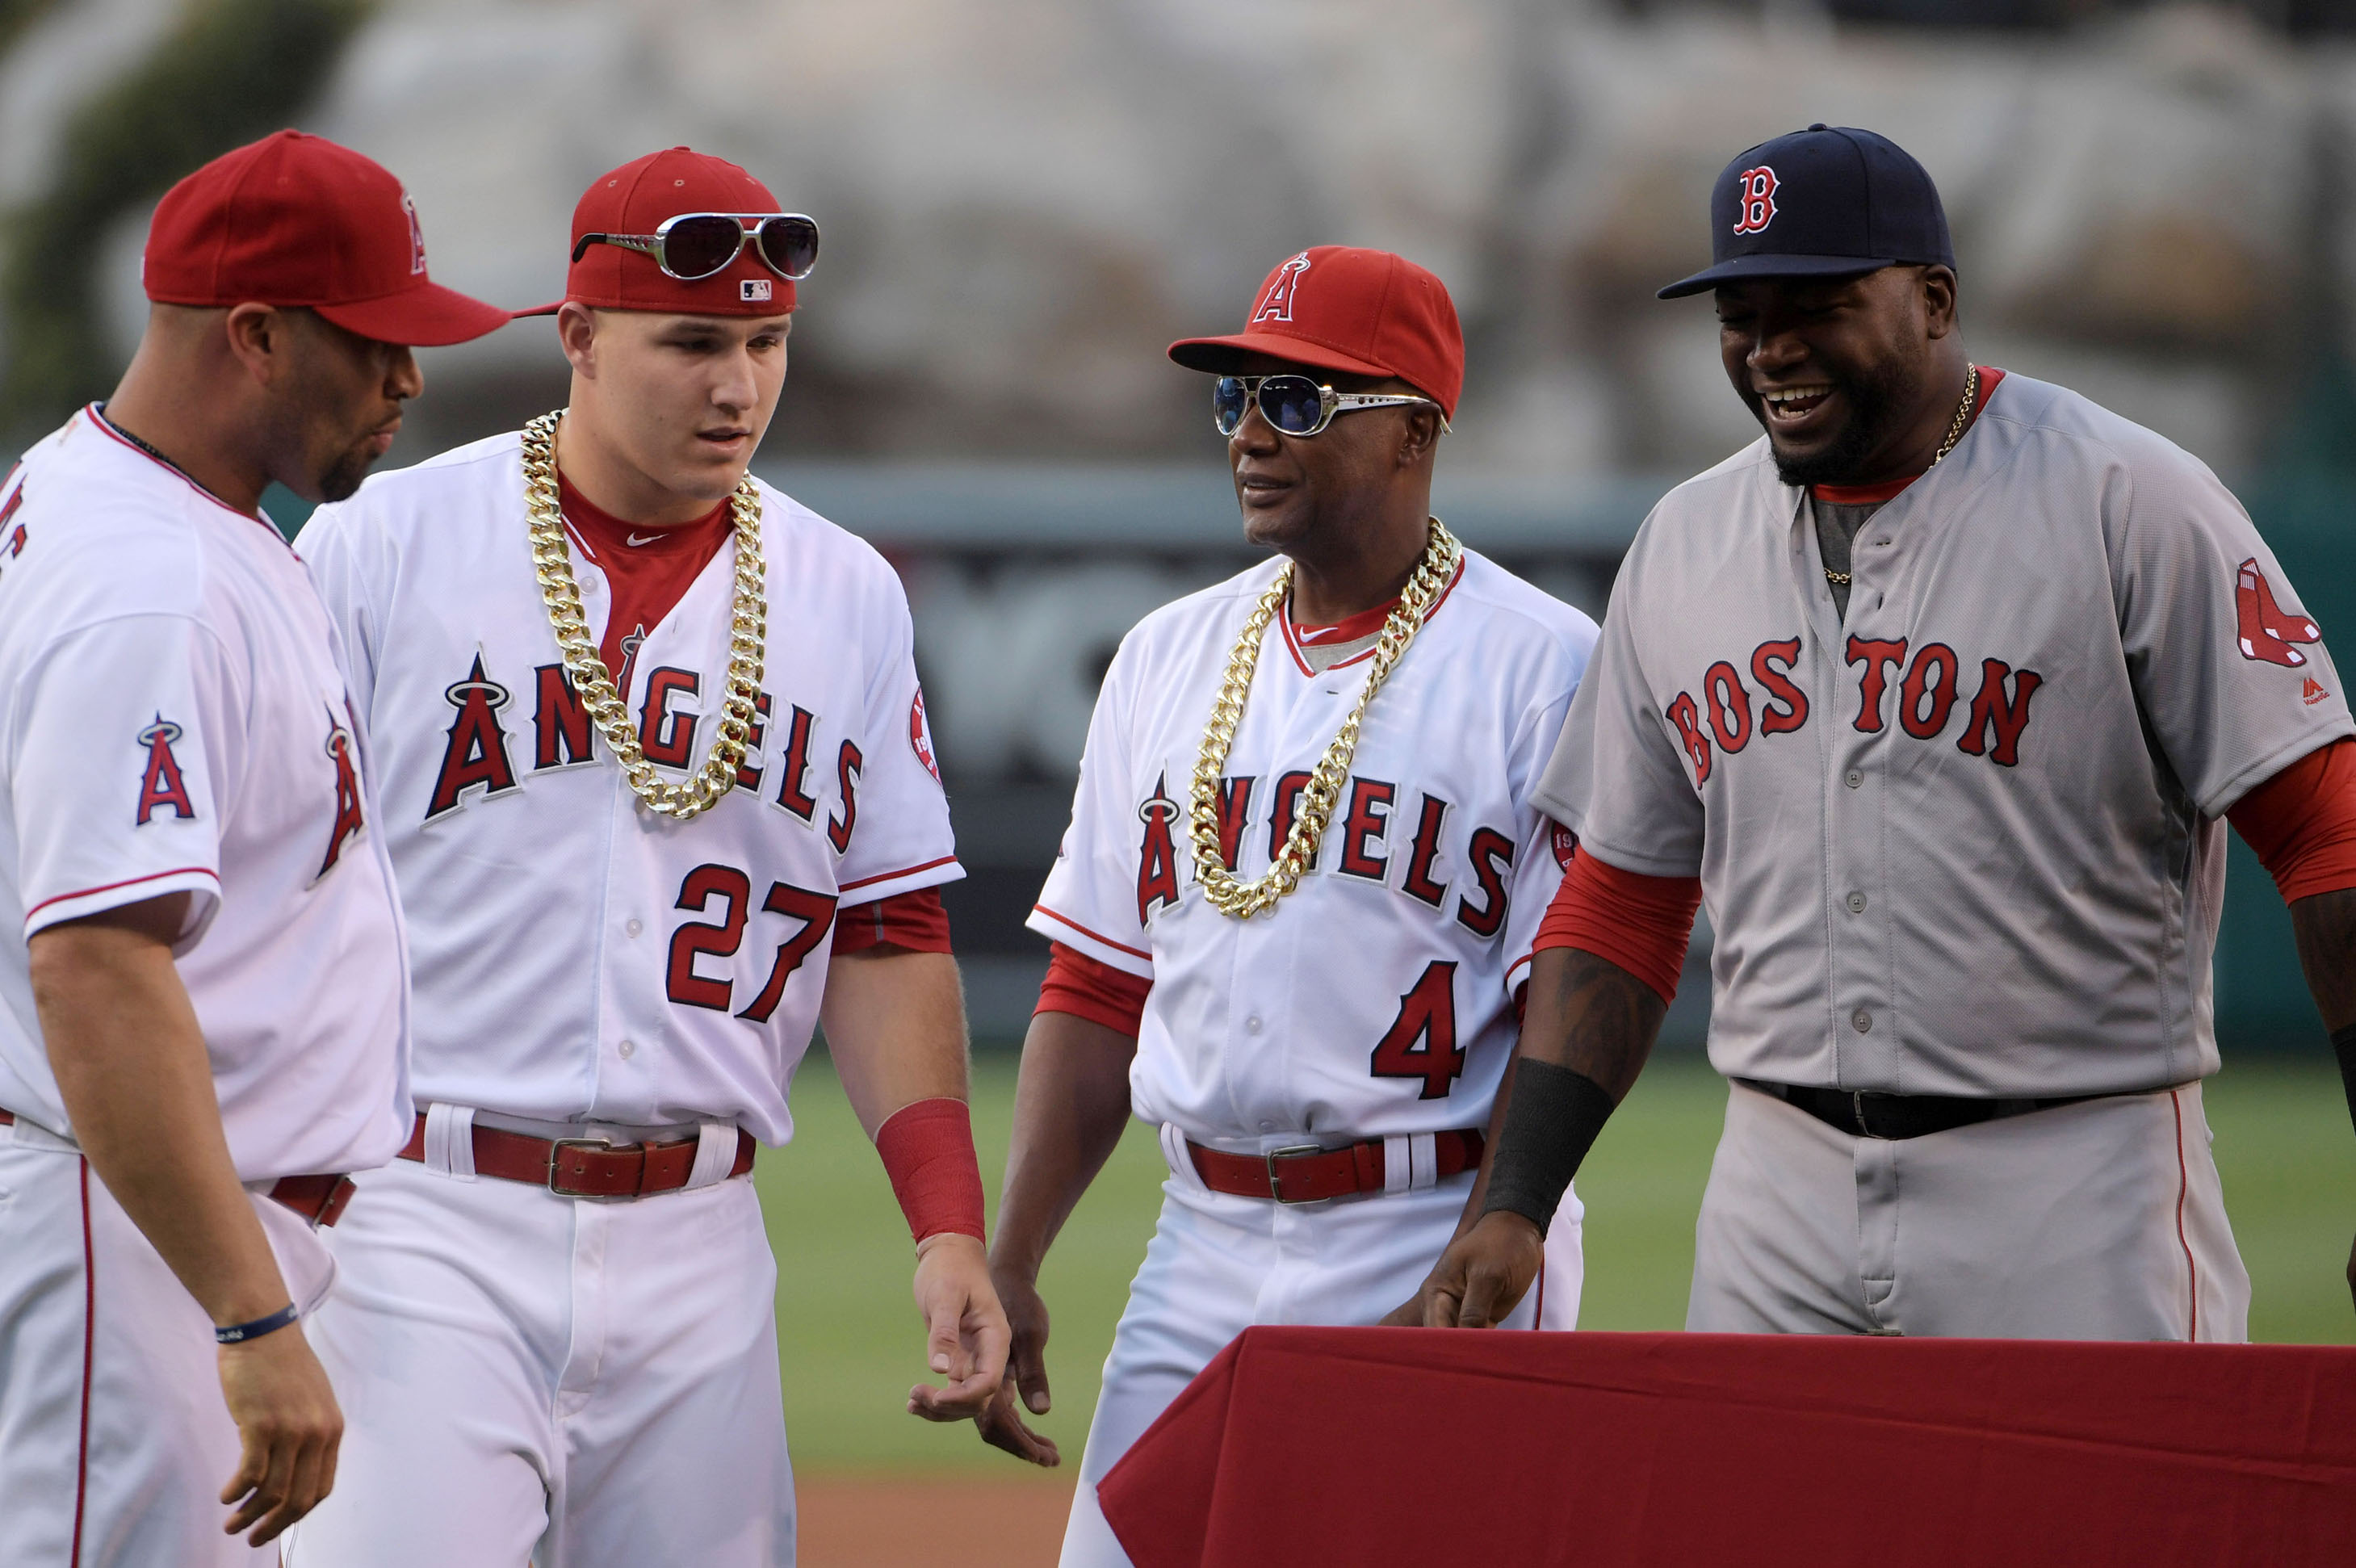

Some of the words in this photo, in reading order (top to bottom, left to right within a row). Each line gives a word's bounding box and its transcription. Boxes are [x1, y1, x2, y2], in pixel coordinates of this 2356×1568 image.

[1733, 166, 1781, 236] B
[1252, 252, 1311, 322] A
[136, 711, 195, 826] A
[315, 683, 368, 880] A
[1665, 635, 2044, 790] BOSTON
[1137, 765, 1516, 940] ANGELS
[666, 863, 840, 1023] 27
[1370, 959, 1468, 1101] 4
